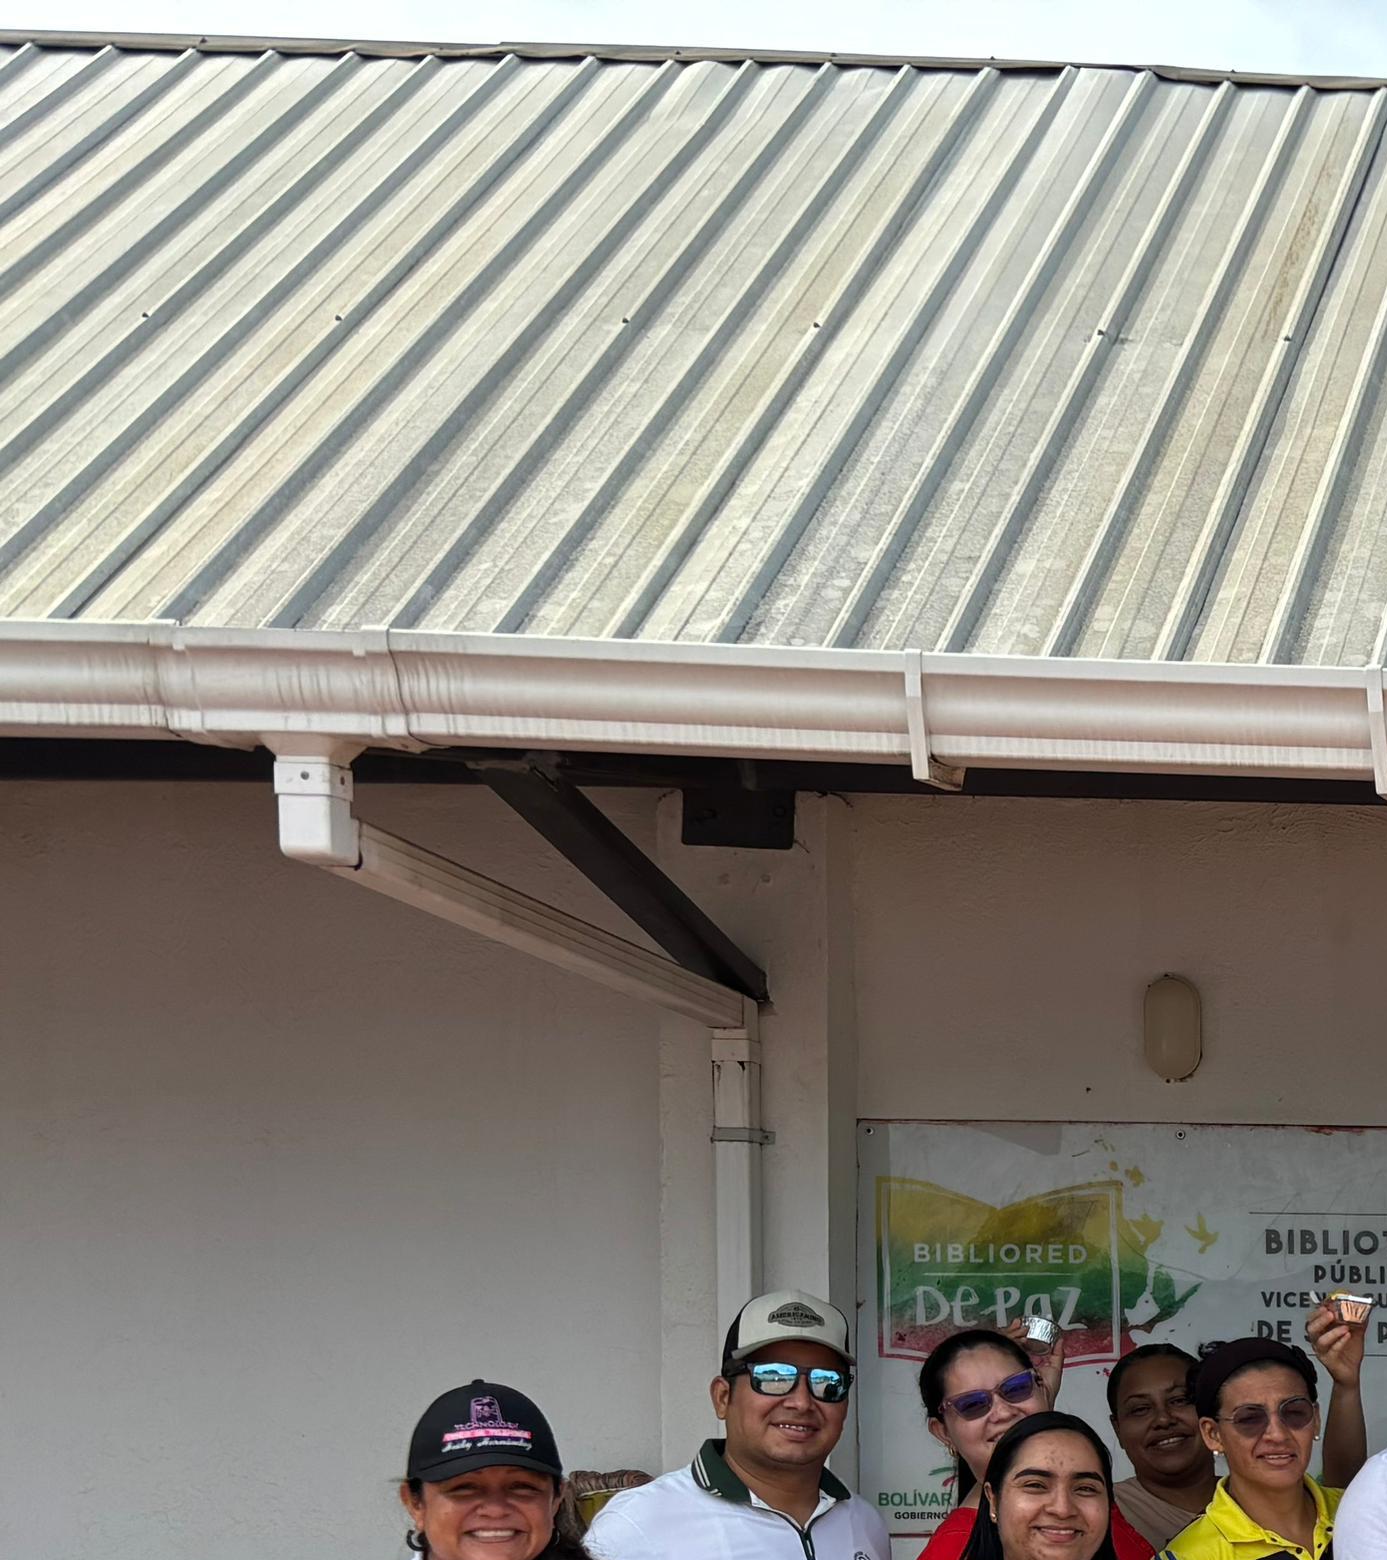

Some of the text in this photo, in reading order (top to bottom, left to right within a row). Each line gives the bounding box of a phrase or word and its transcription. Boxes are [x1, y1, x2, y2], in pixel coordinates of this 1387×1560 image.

[913, 1242, 1088, 1264] BIBLIORED
[1257, 1320, 1292, 1343] DE
[878, 1489, 952, 1506] BOLÍVAR
[894, 1511, 949, 1520] GOBIERNO
